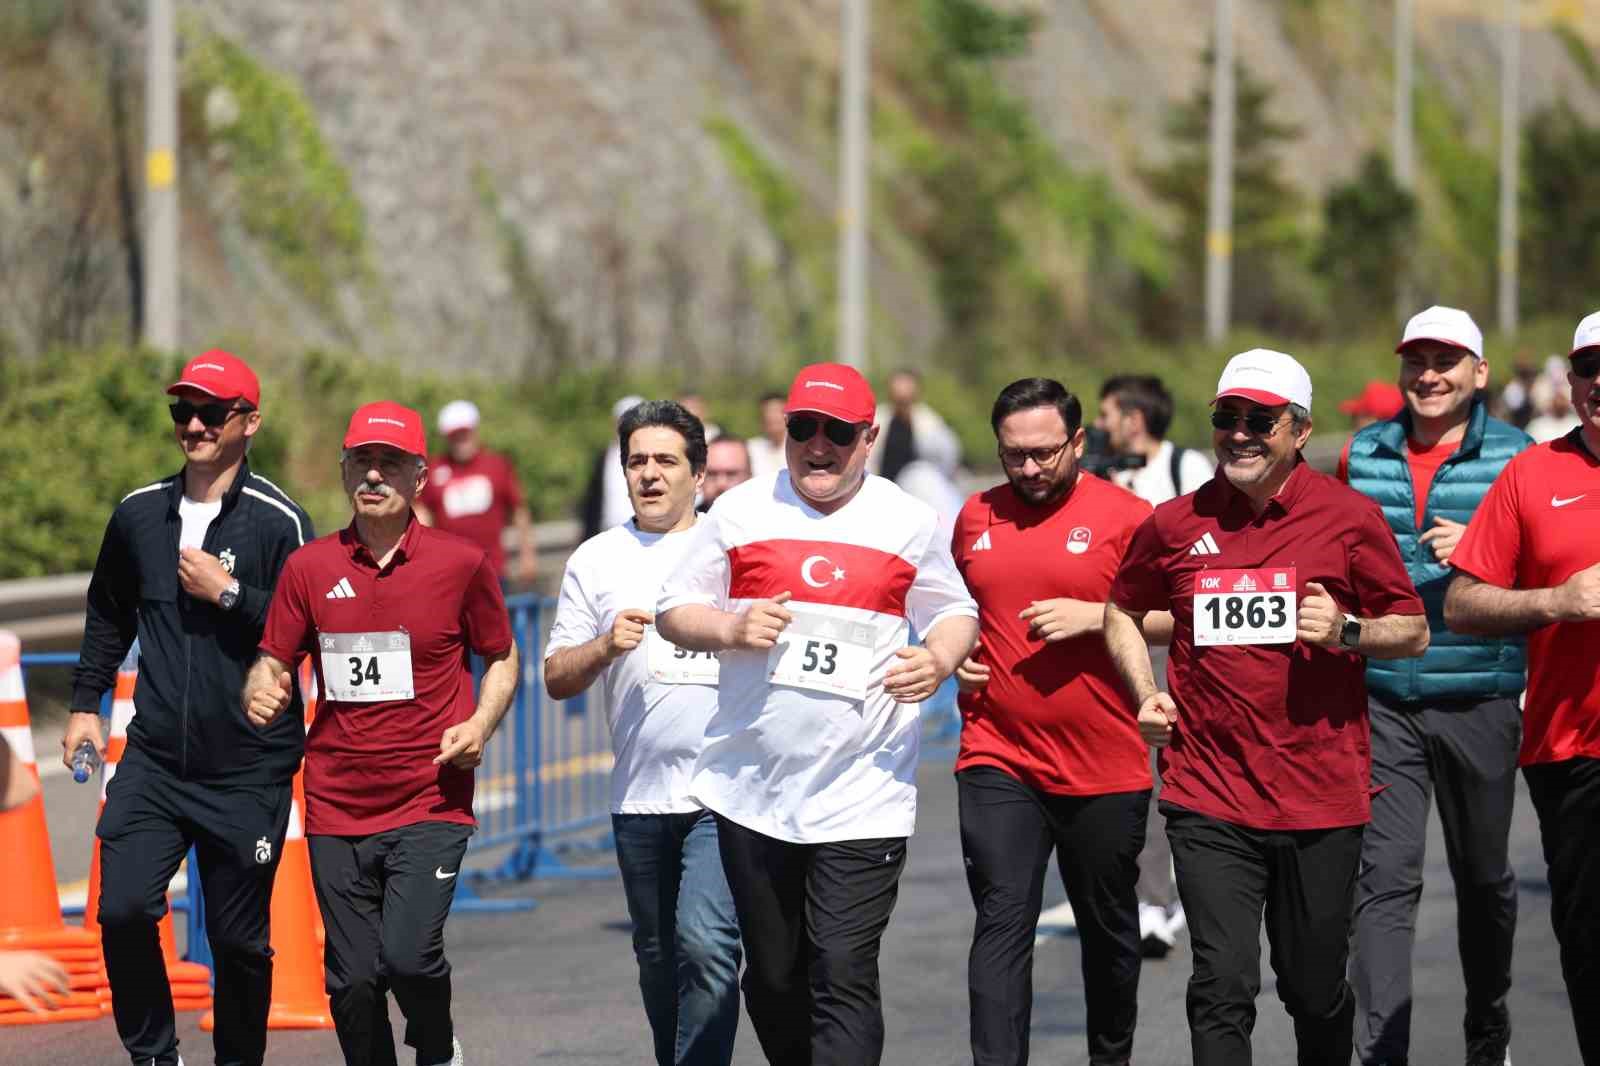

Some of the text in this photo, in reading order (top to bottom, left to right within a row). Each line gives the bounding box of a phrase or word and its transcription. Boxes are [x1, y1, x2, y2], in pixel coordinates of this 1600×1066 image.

[1200, 577, 1221, 589] 10K
[1204, 595, 1287, 629] 1863
[348, 656, 382, 687] 34
[802, 640, 837, 675] 53
